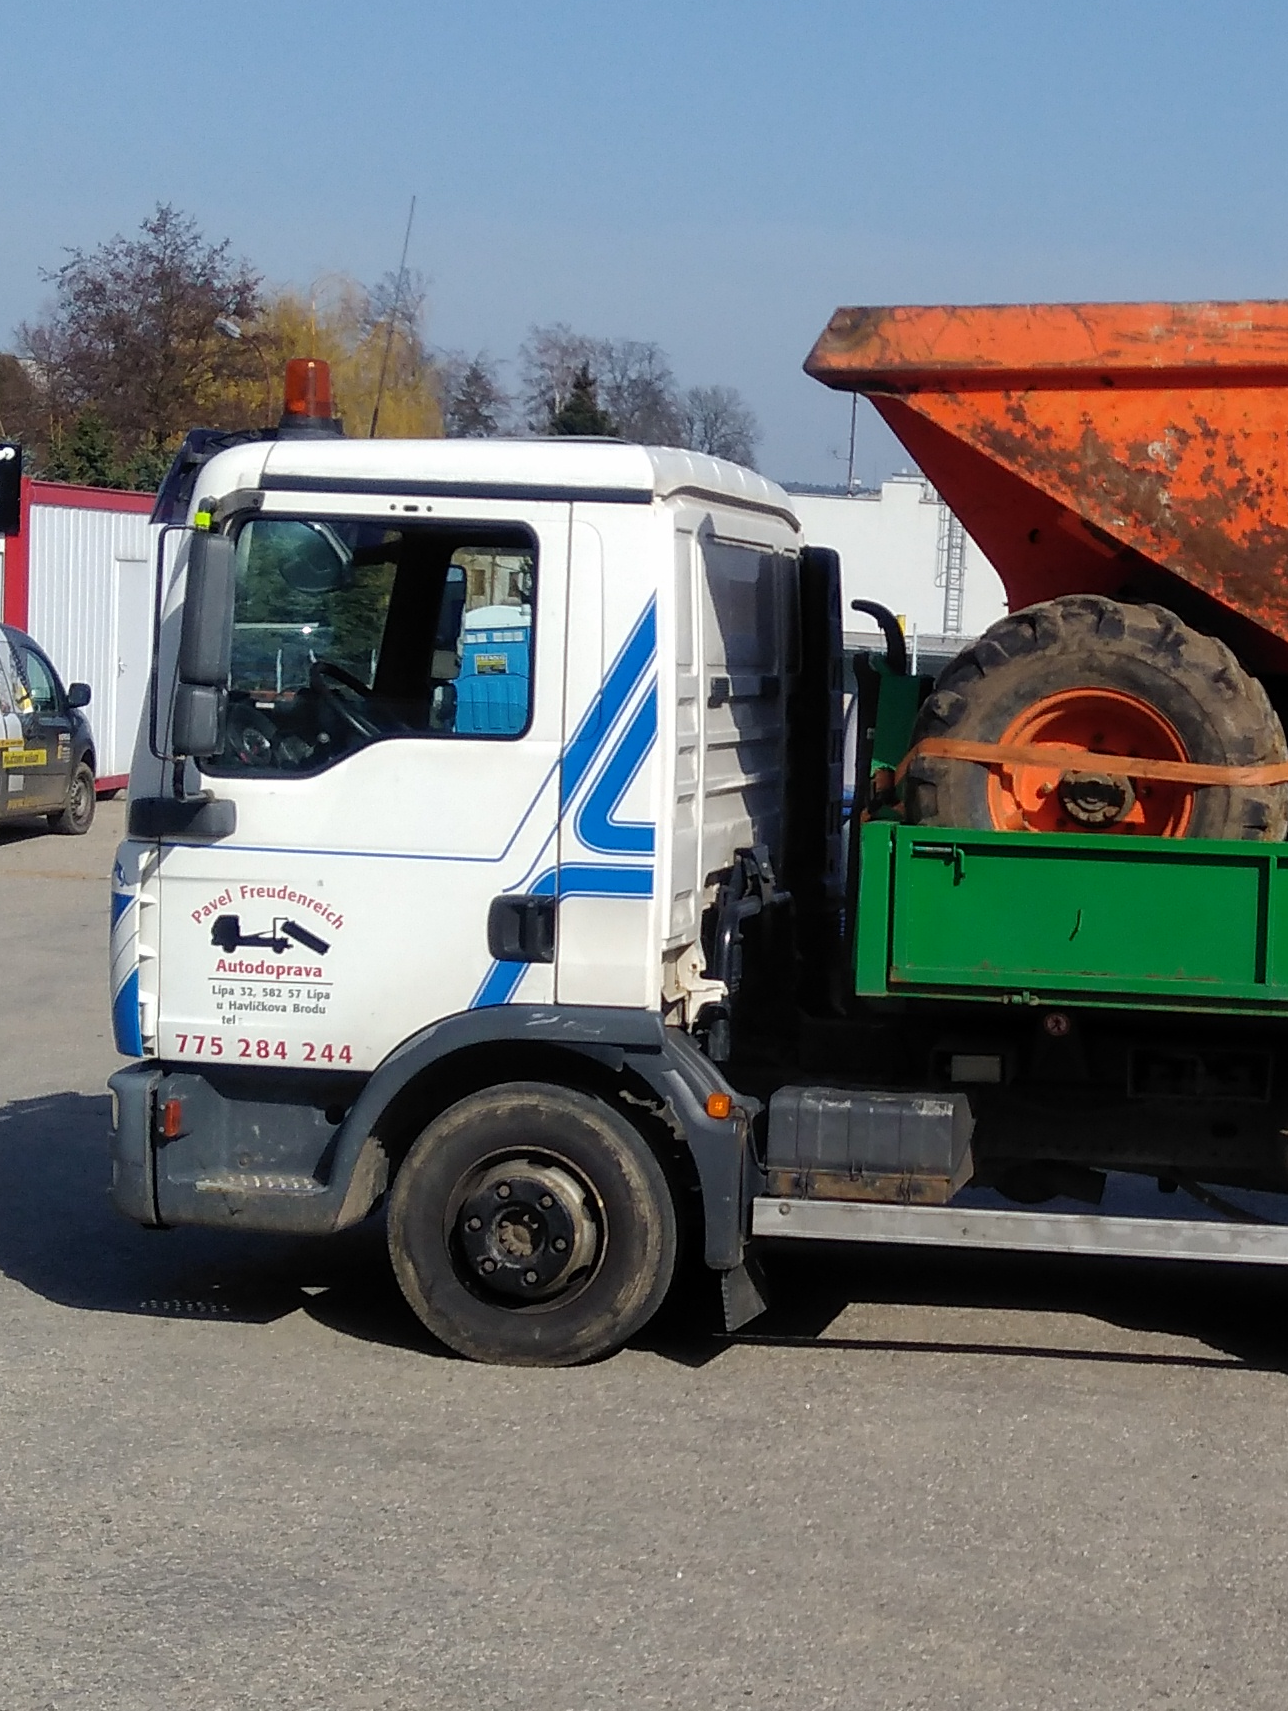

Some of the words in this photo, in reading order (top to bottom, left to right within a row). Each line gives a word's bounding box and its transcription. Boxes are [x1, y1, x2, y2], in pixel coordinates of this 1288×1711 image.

[191, 889, 233, 924] Pavel
[240, 885, 345, 930] Freudenreich
[215, 958, 323, 979] Autodoprava
[240, 985, 257, 998] 32,
[262, 987, 282, 998] 582
[288, 989, 301, 999] 57
[216, 1002, 223, 1010] u
[228, 1001, 287, 1012] Havlíčkova
[293, 1003, 326, 1014] Brodu
[175, 1034, 224, 1056] 775
[237, 1038, 288, 1060] 284
[301, 1042, 353, 1063] 244
